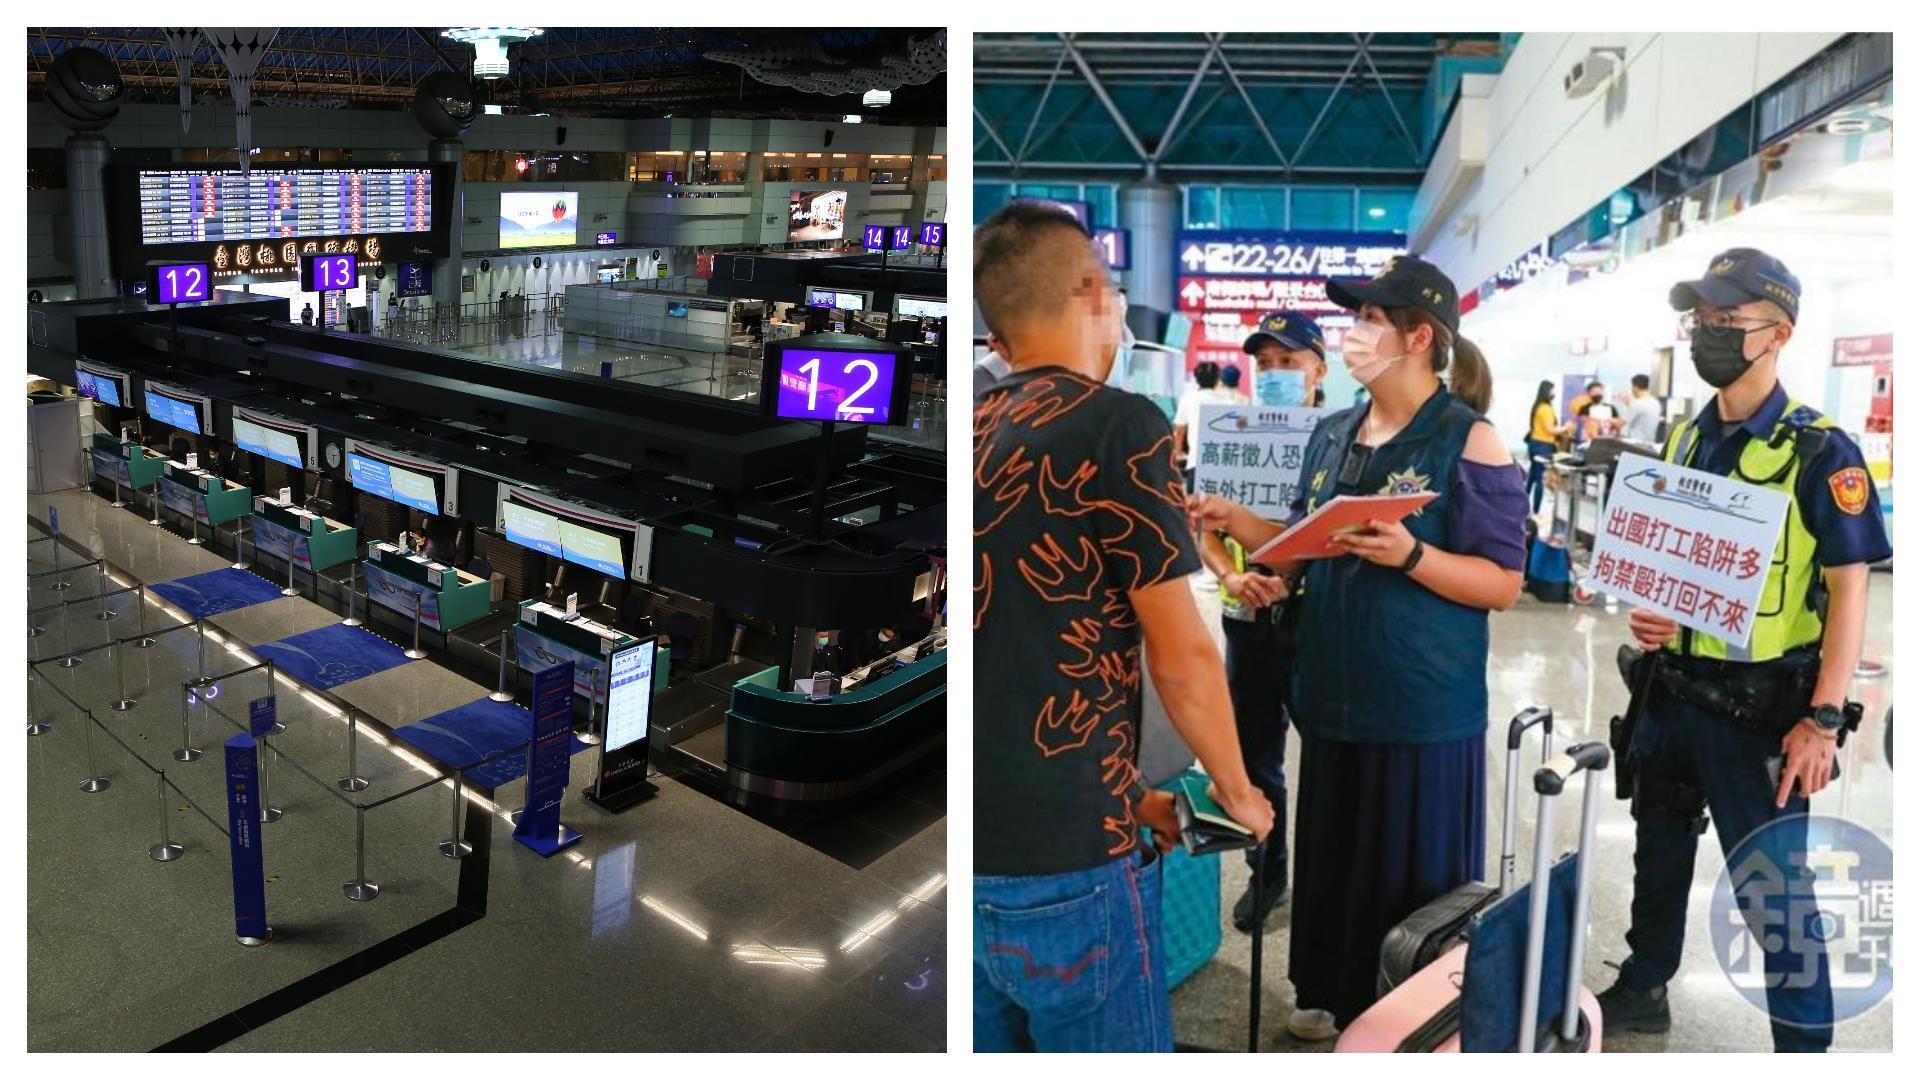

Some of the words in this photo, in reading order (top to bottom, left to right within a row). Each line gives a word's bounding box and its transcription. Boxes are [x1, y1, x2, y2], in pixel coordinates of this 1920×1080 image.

[867, 228, 882, 246] 14
[896, 228, 909, 247] 14
[925, 225, 940, 243] 15
[166, 267, 202, 298] 12
[320, 258, 350, 287] 13
[799, 358, 878, 414] 12
[1606, 507, 1761, 580] 出國打工陷阱多
[1593, 551, 1748, 634] 拘禁毆打回不來
